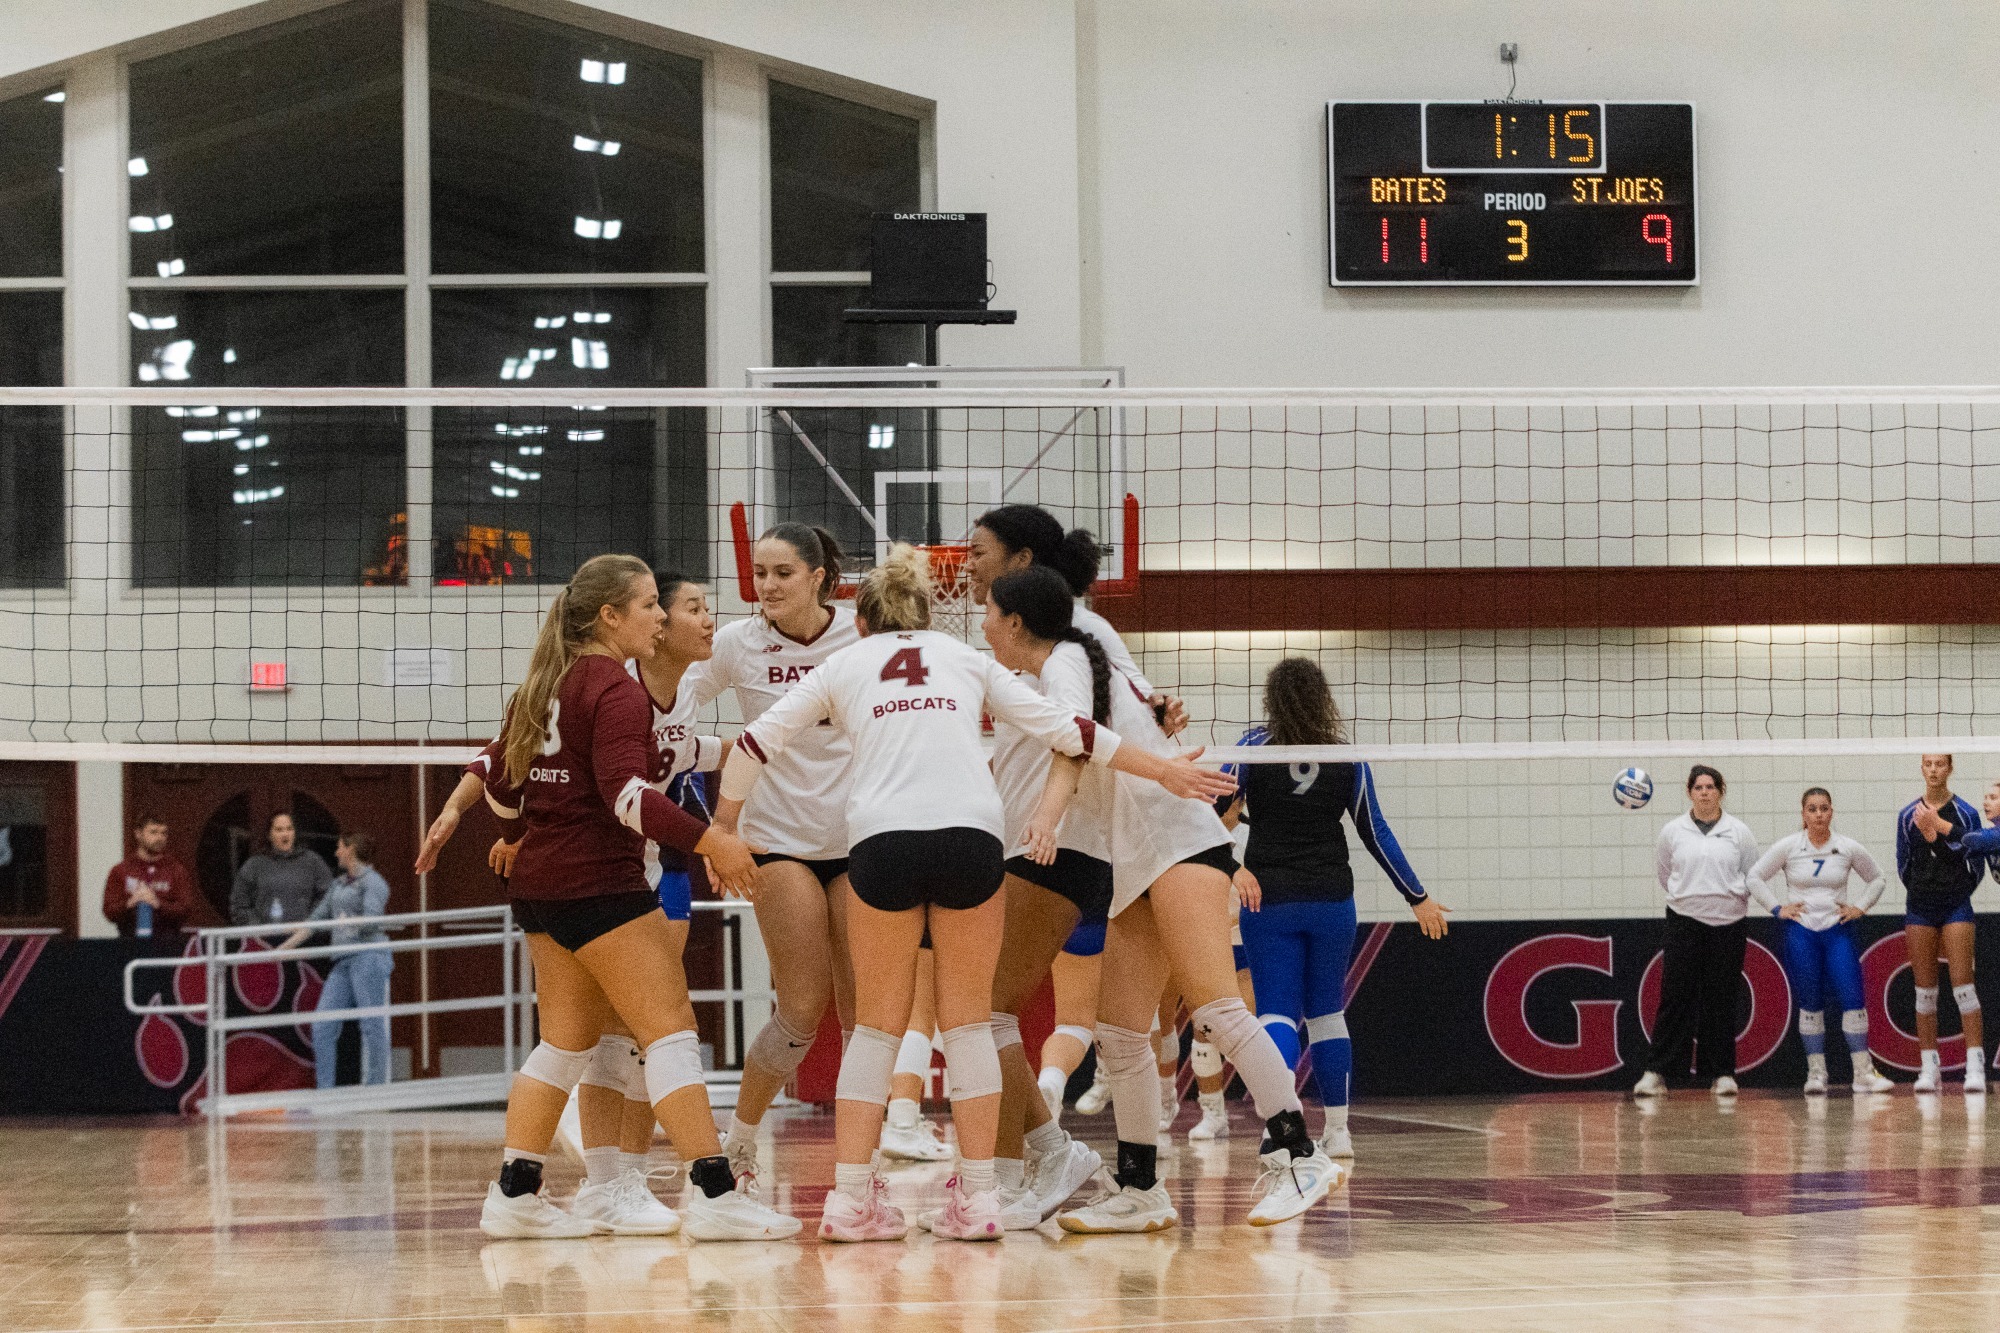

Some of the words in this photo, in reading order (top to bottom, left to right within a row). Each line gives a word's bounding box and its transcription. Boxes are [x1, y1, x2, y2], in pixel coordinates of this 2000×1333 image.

[1495, 110, 1594, 163] 1:15
[1371, 177, 1447, 203] BATES
[1484, 192, 1547, 211] PERIOD
[893, 212, 966, 221] DAKTRONICS
[1381, 217, 1428, 264] 11
[1506, 219, 1528, 261] 3
[1642, 213, 1673, 264] 9
[768, 665, 819, 684] BAT
[879, 646, 931, 688] 4
[872, 697, 957, 719] BOBCATS
[1288, 762, 1320, 795] 9
[1812, 859, 1825, 877] 7
